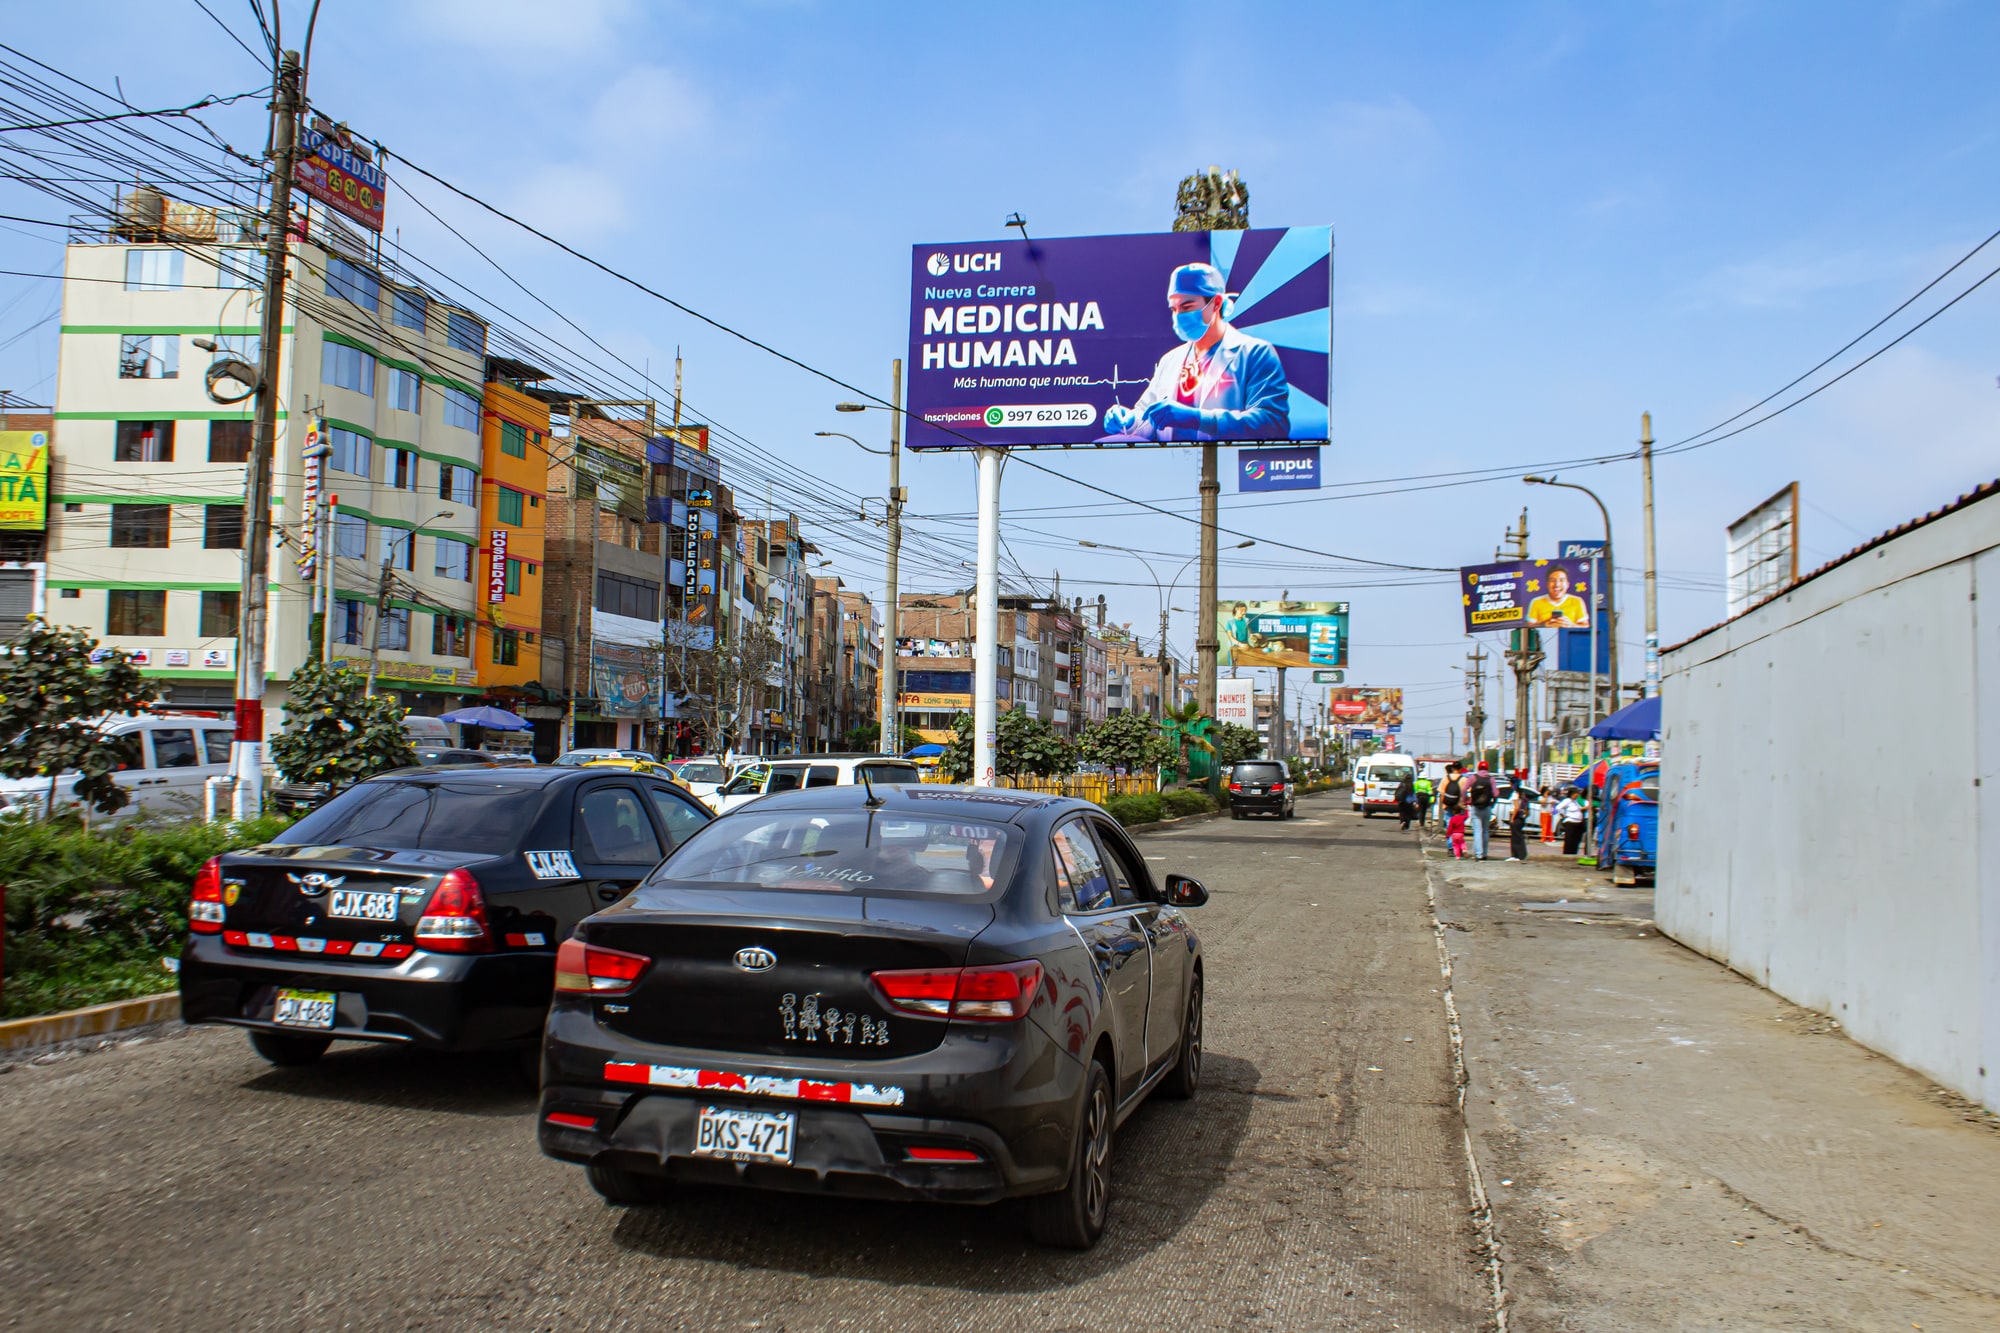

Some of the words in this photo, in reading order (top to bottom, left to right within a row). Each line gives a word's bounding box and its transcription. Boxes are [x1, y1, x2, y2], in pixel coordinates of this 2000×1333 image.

[329, 170, 341, 190] 25
[344, 179, 357, 200] 30
[360, 189, 373, 208] 40
[954, 252, 1002, 273] UCH
[924, 286, 972, 300] Nueva
[977, 284, 1036, 298] Carrera
[923, 301, 1105, 336] MEDICINA
[922, 338, 1078, 370] HUMANA
[953, 377, 977, 389] Más
[979, 376, 1028, 388] humana
[1029, 377, 1051, 389] que
[1053, 375, 1089, 386] nunca
[924, 412, 982, 423] Inscripciones
[1007, 411, 1033, 422] 997
[1036, 410, 1062, 421] 620
[1066, 409, 1089, 421] 126
[1269, 457, 1313, 473] input
[687, 499, 713, 507] PISCIS
[702, 530, 713, 540] 20
[686, 513, 698, 595] HOSPEDAJE
[490, 530, 507, 602] HOSPEDAJE
[1476, 582, 1517, 594] Apuesta
[1481, 592, 1499, 603] por
[1499, 591, 1512, 600] tu
[1478, 599, 1516, 612] EQUIPO
[1474, 608, 1520, 622] FAVORITO
[1218, 693, 1246, 704] ANUNCIE
[331, 892, 396, 919] CJX-683
[738, 952, 769, 967] KIA
[728, 1110, 765, 1122] PERU
[700, 1117, 789, 1155] BKS-471
